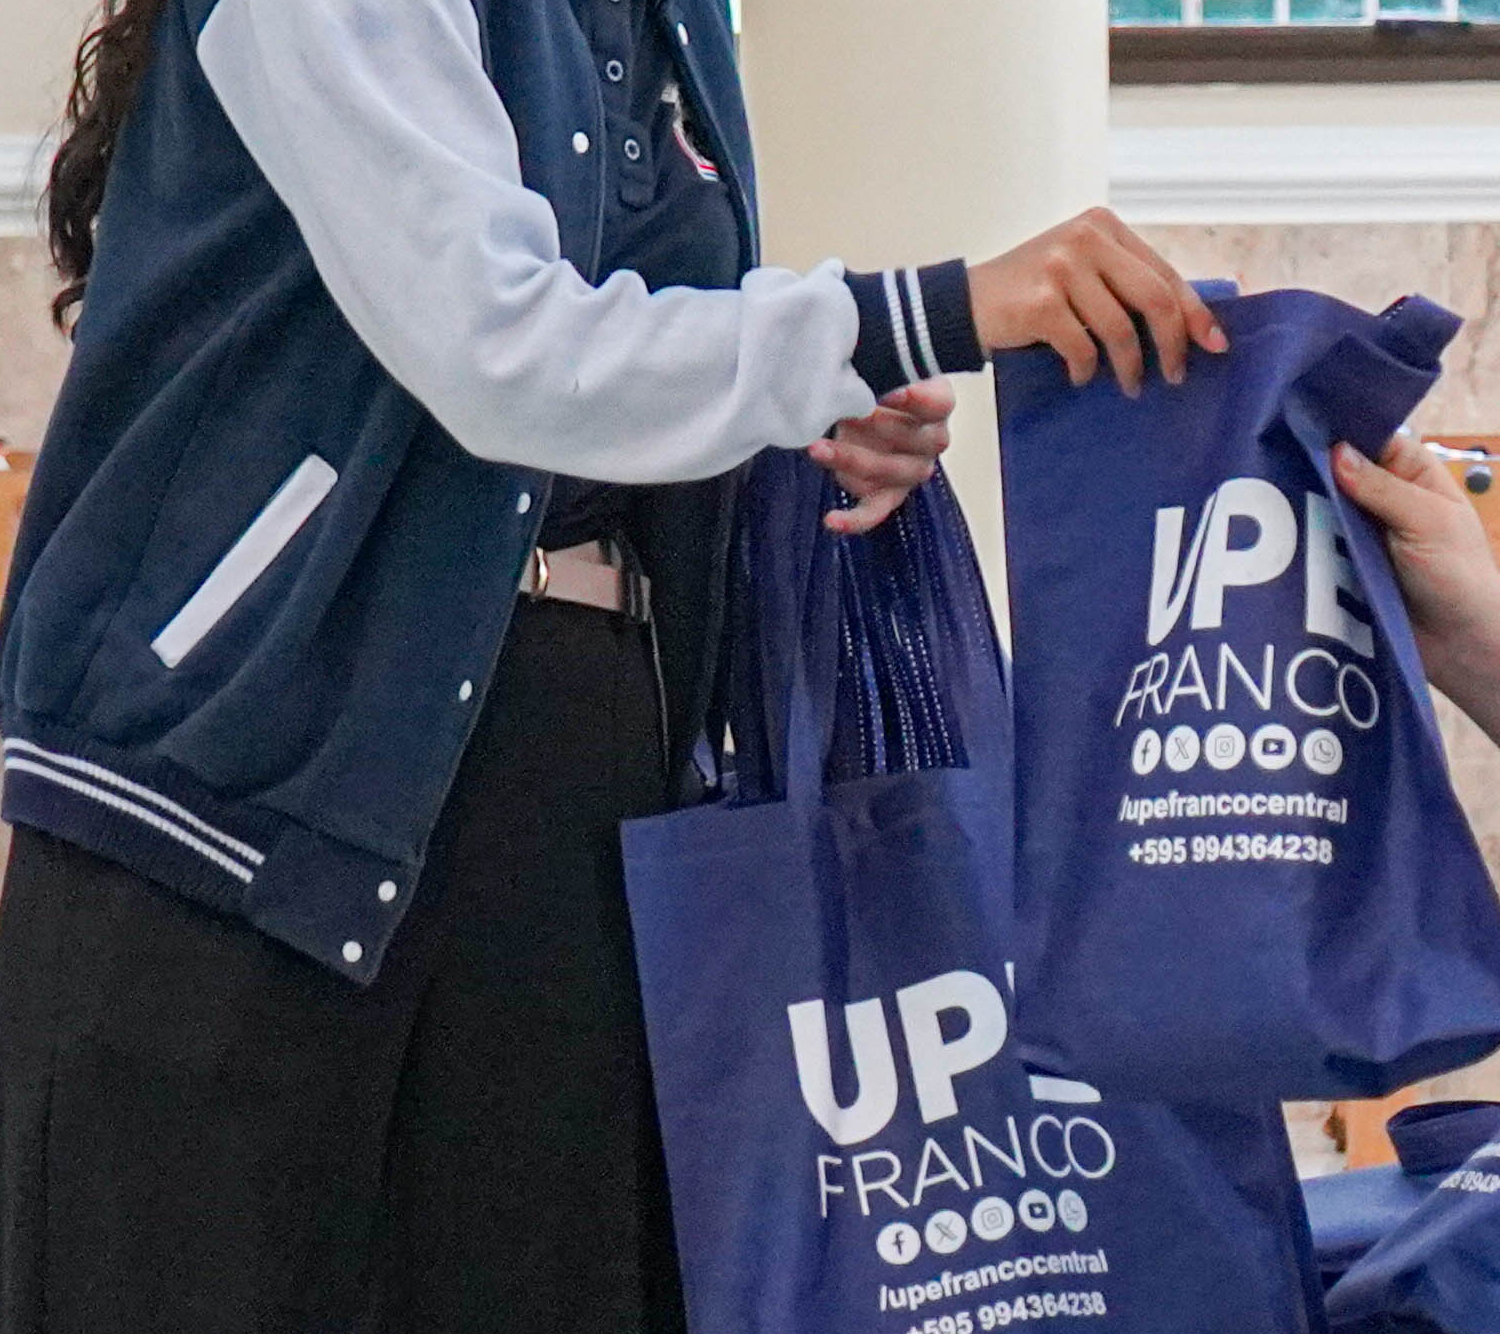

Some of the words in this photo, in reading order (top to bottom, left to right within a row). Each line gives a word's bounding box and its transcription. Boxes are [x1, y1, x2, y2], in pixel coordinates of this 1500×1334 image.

[1114, 643, 1379, 729] FRANCO
[1119, 790, 1348, 826] /upefrancocentral
[1128, 837, 1187, 864] +595
[1191, 833, 1333, 864] 994364238
[787, 961, 1102, 1145] UP
[817, 1114, 1115, 1217] FRANCO
[879, 1249, 1108, 1312] /upefrancocentral
[977, 1291, 1107, 1330] 994364238
